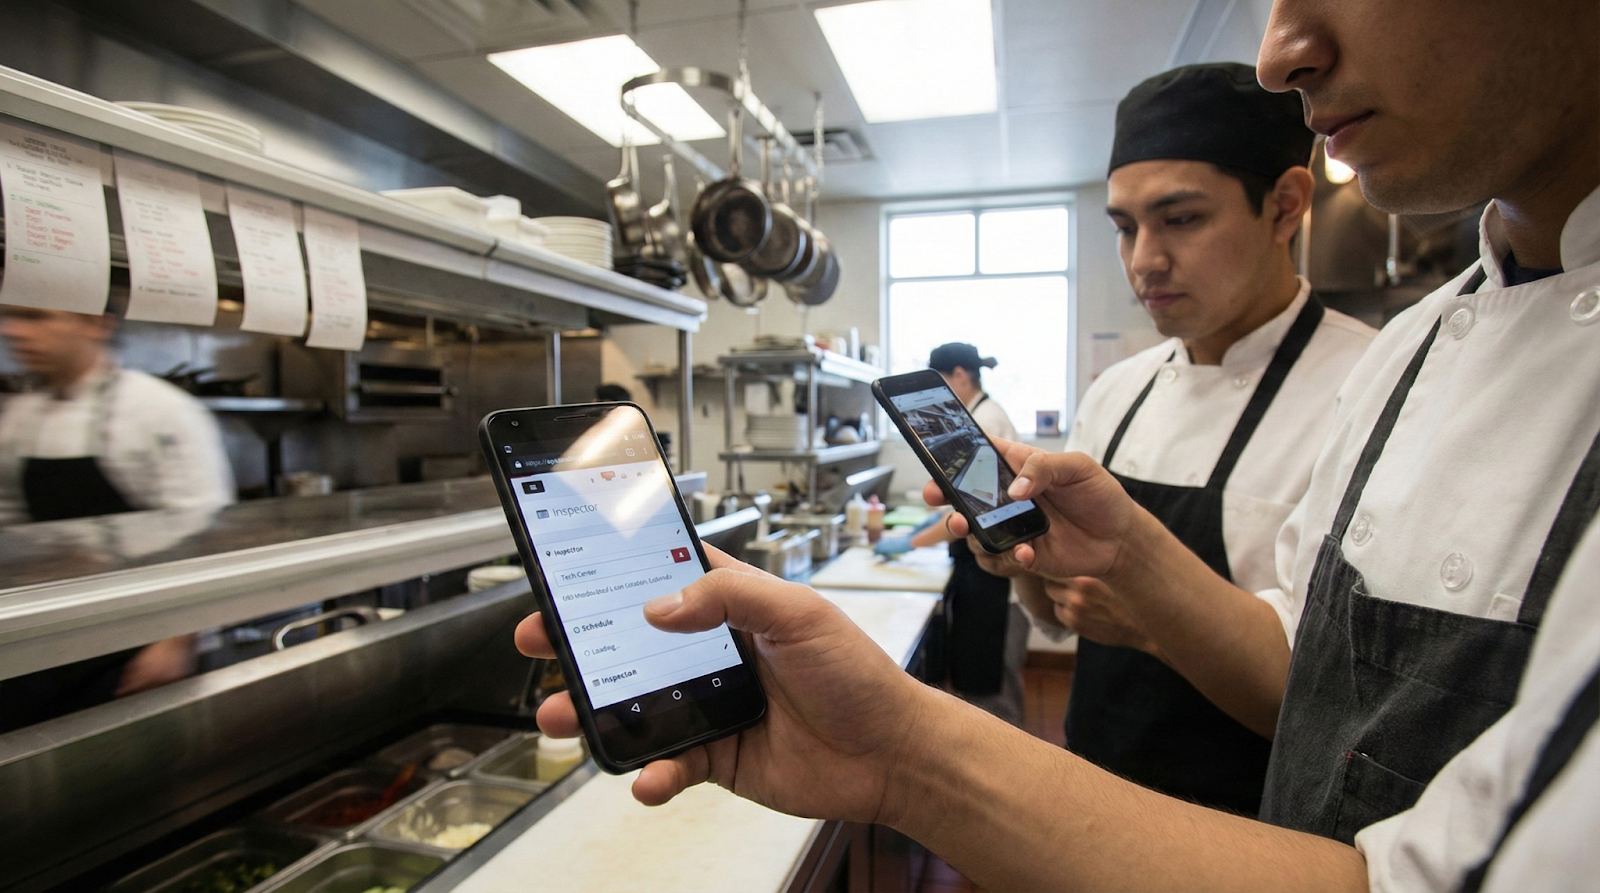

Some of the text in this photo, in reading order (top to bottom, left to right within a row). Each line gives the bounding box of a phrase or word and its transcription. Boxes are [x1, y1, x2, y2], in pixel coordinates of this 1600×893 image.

[552, 503, 598, 518] Inspector
[560, 569, 597, 581] Tech Center
[581, 619, 614, 632] Schedule
